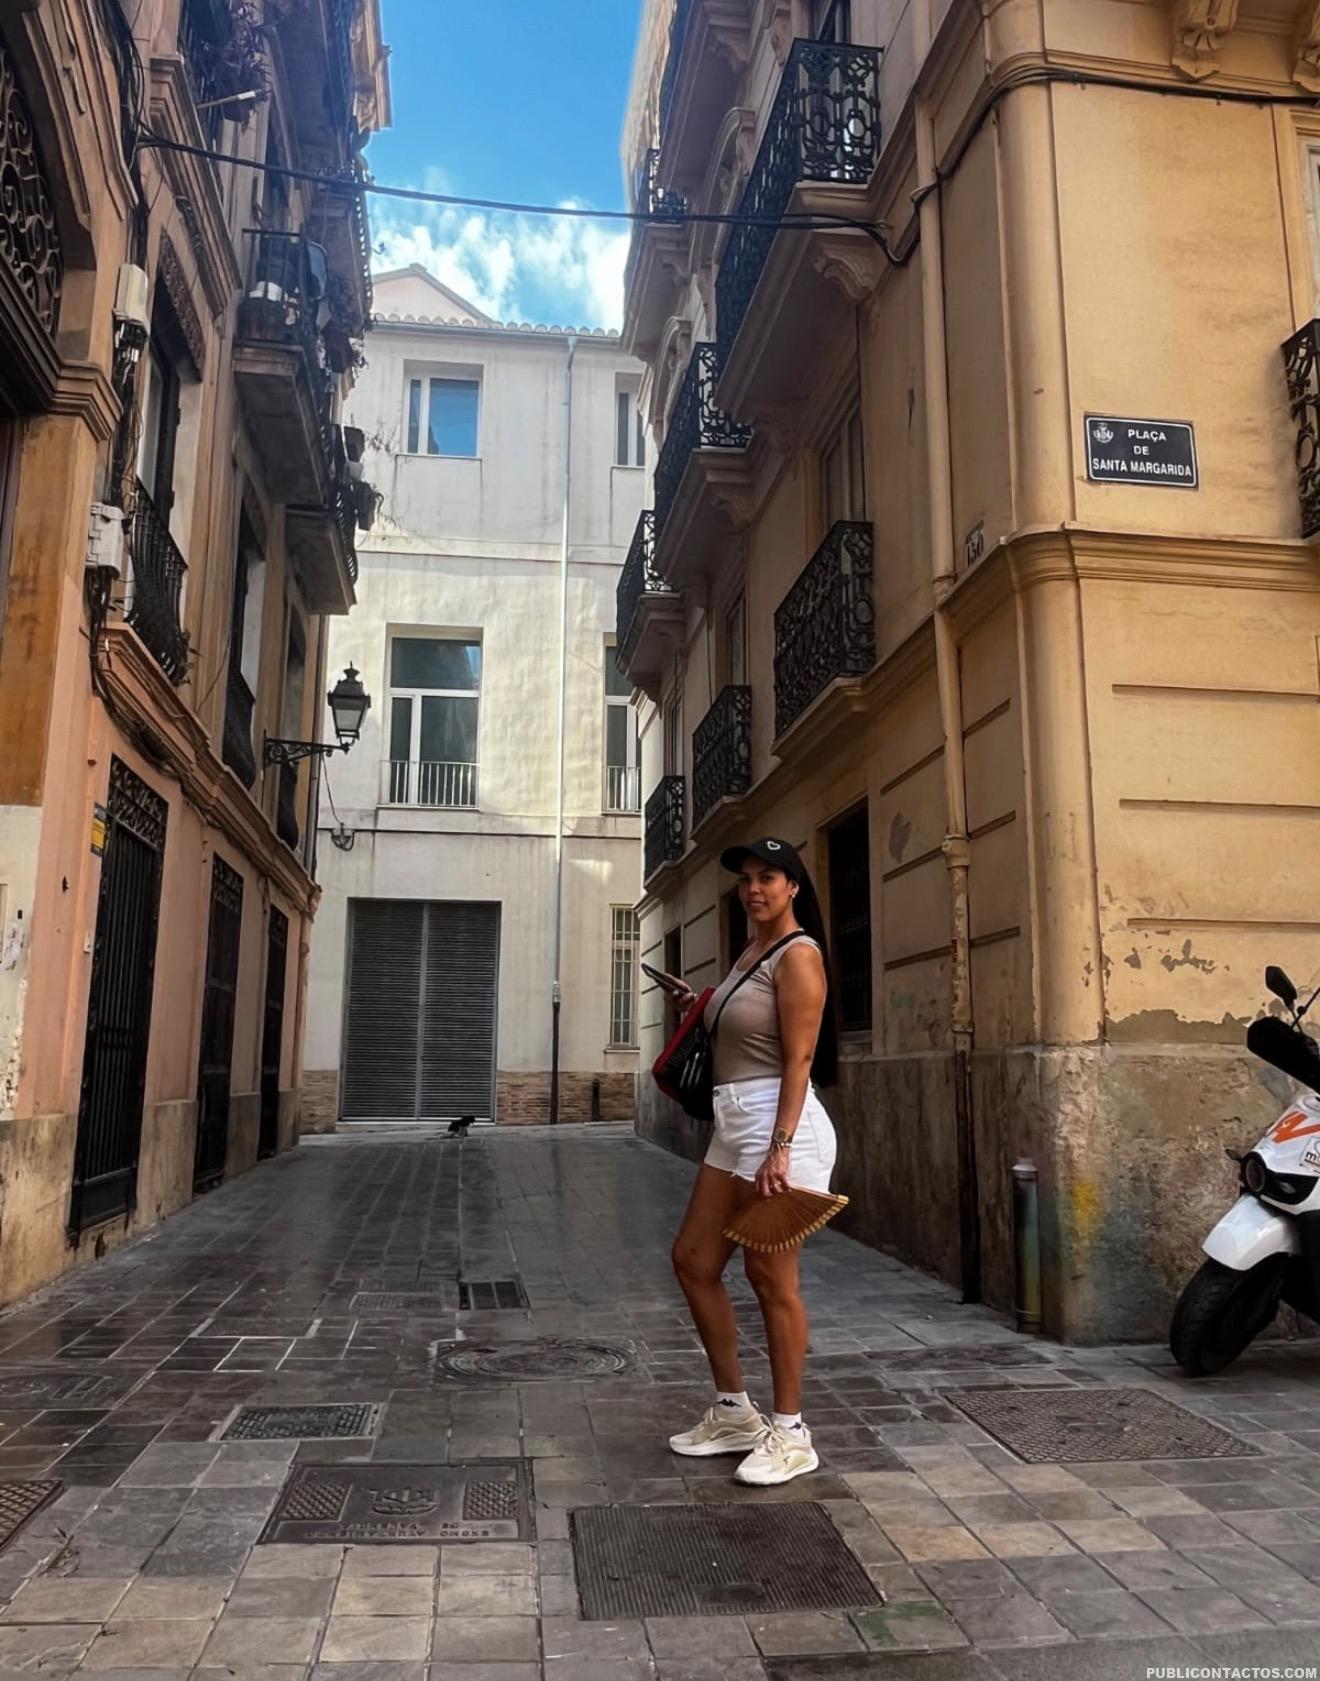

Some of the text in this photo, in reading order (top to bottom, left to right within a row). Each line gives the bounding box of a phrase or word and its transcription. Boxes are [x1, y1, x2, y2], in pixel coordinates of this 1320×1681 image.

[1128, 429, 1167, 443] PLAÇA
[1133, 445, 1150, 456] DE
[1092, 458, 1192, 477] SANTA MARGARIDA
